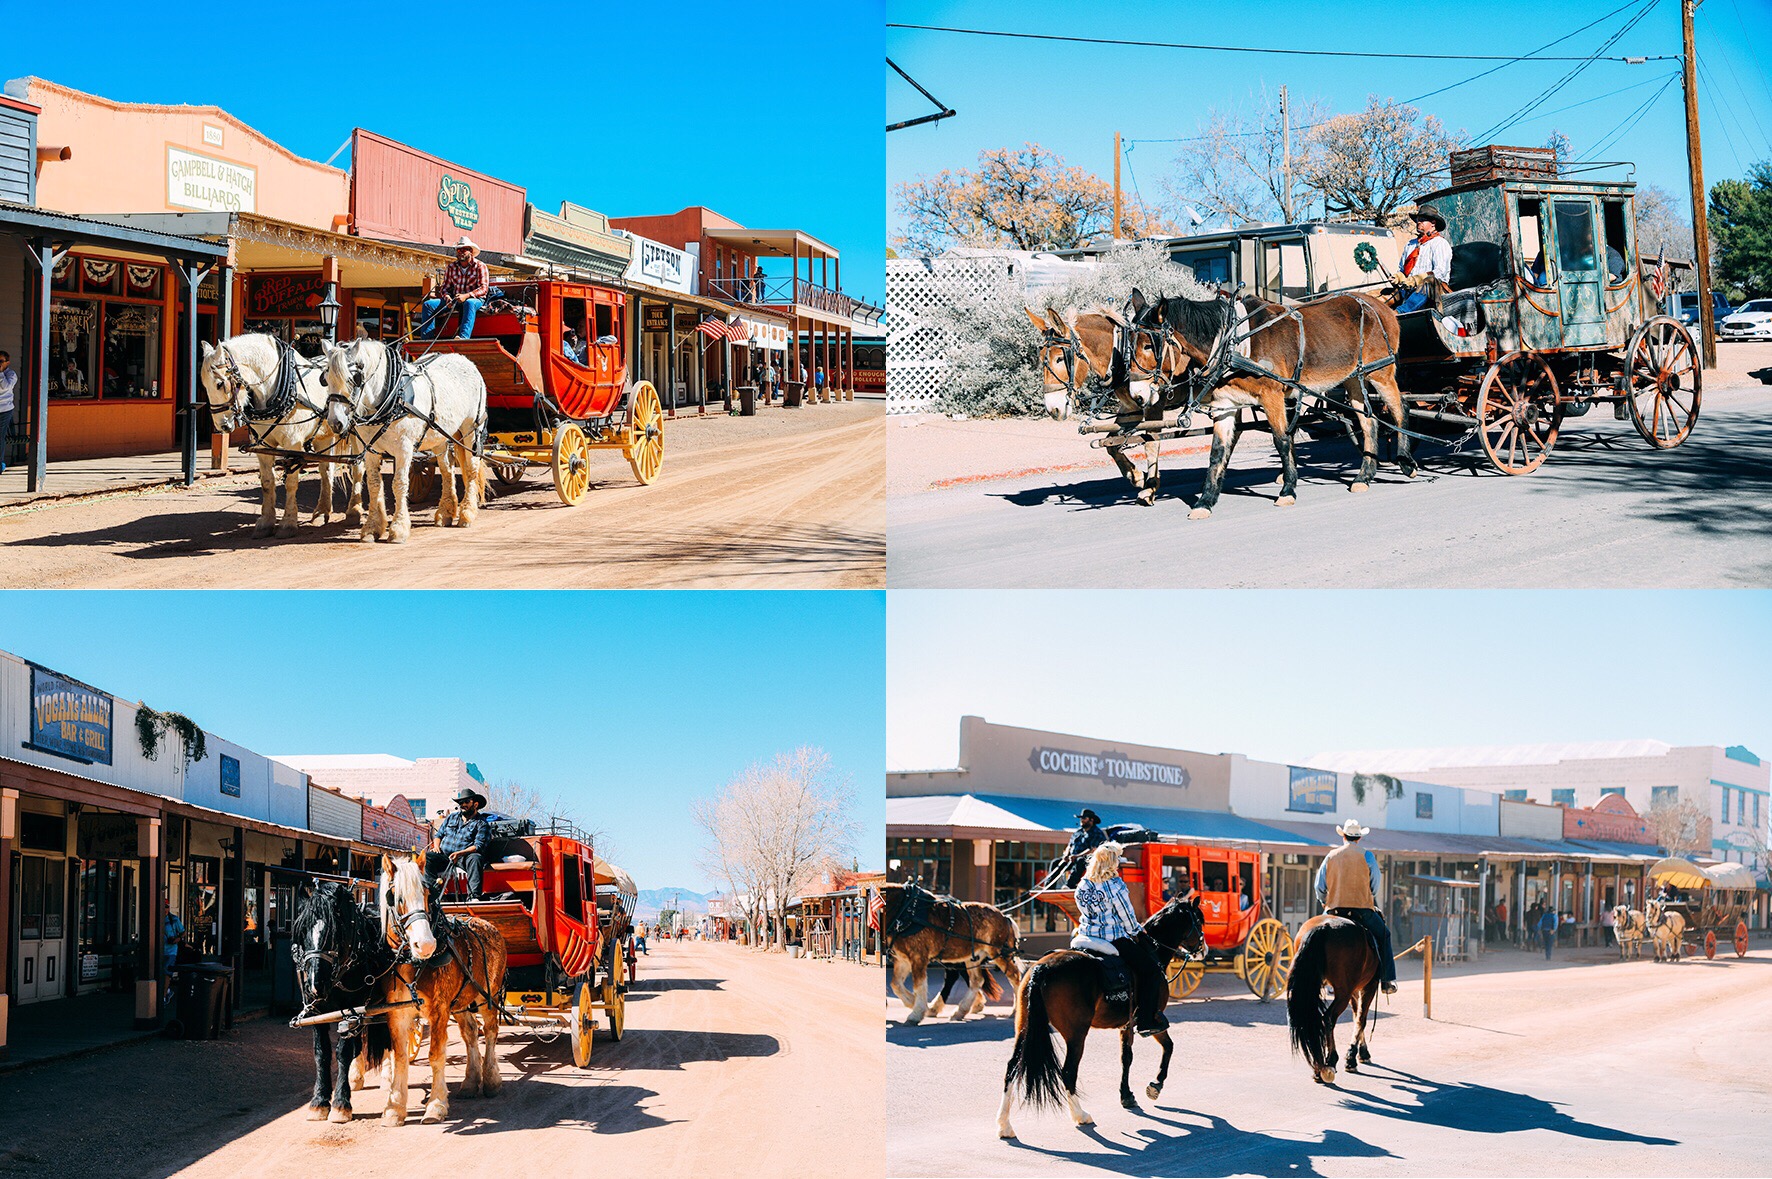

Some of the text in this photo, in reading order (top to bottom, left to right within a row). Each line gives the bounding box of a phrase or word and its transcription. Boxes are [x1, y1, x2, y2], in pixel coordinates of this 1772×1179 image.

[206, 130, 221, 142] 1880
[171, 159, 253, 196] CAMPBELL & HATCH
[440, 176, 471, 211] SPUR
[184, 182, 242, 212] BILLIARDS
[645, 243, 681, 277] STETSON
[254, 277, 325, 312] BUFFALO
[261, 276, 292, 299] RED
[80, 694, 110, 729] ALLEY
[61, 721, 77, 742] BAR
[79, 727, 84, 742] &
[85, 728, 106, 751] GRILL
[1040, 750, 1099, 776] COCHISE
[1105, 758, 1184, 786] TOMBSTONE
